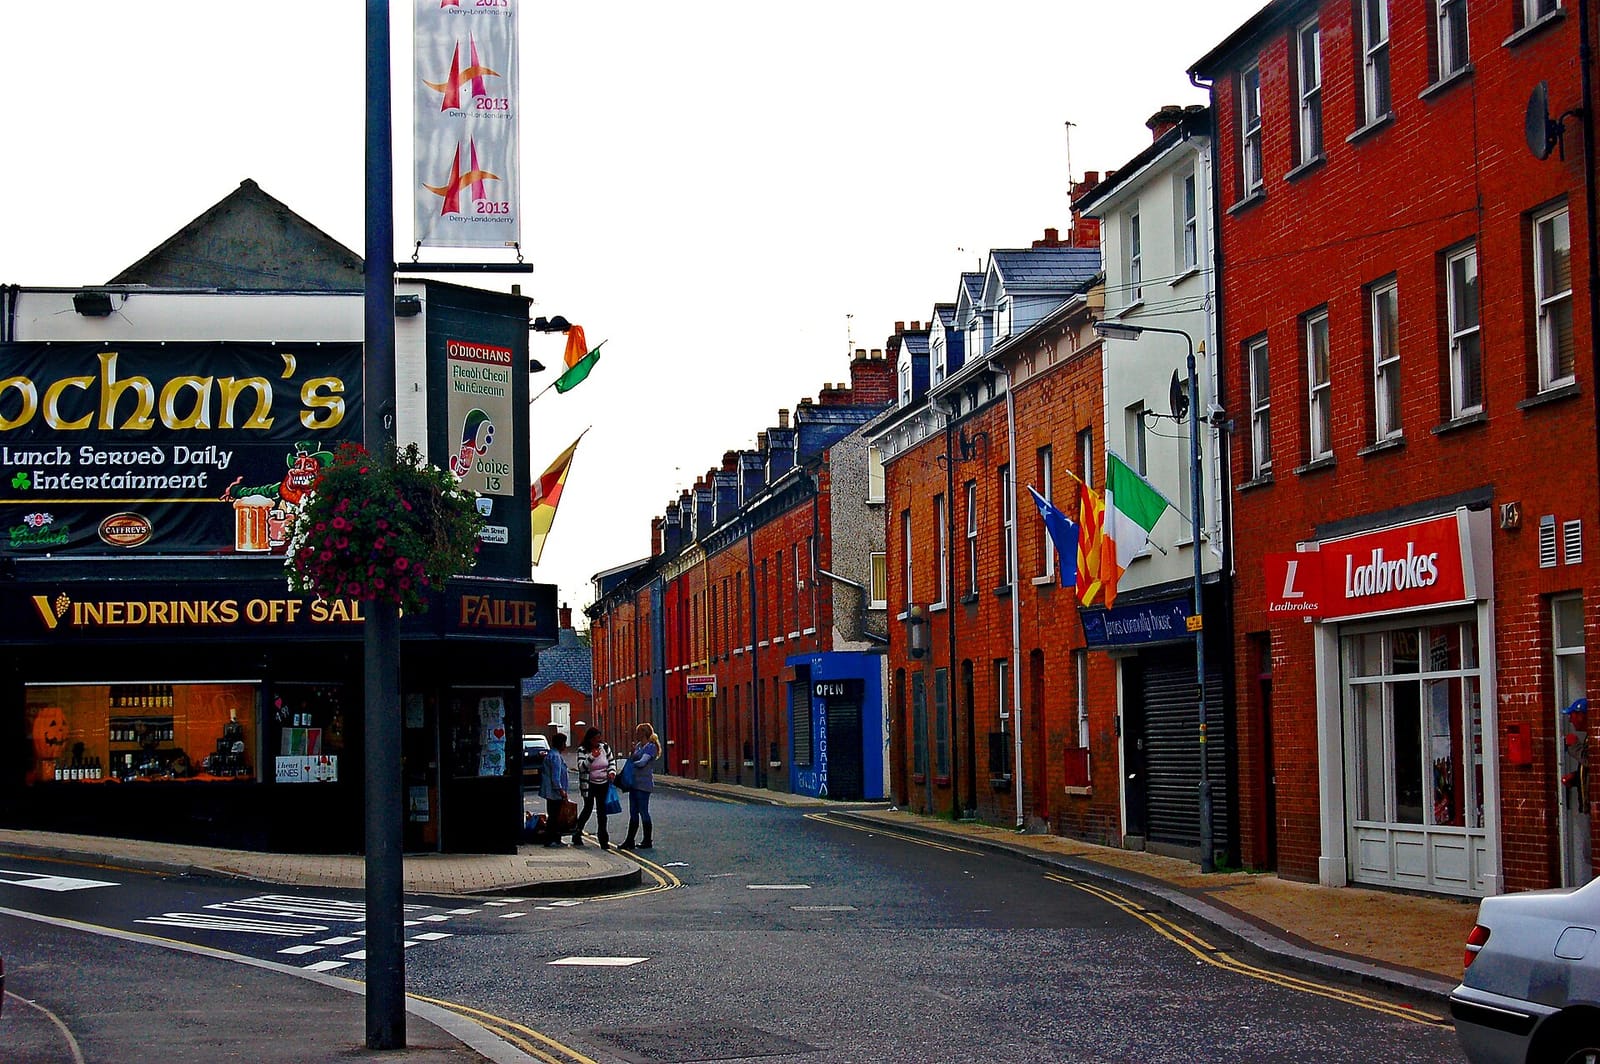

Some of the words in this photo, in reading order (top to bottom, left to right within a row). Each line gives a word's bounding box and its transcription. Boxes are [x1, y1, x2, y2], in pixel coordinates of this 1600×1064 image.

[476, 98, 508, 110] 2013
[477, 202, 509, 214] 2013
[449, 343, 511, 363] O'DIOCHANS
[453, 365, 481, 379] Fleadh
[482, 368, 508, 383] Cheoil
[3, 446, 71, 466] Lunch
[79, 445, 165, 466] Served
[173, 445, 233, 470] Daily
[33, 472, 208, 490] Entertainment
[486, 477, 501, 490] 13
[1345, 542, 1439, 599] Ladbrokes
[1282, 561, 1304, 599] L
[246, 599, 301, 623] OFF
[310, 600, 403, 622] SAL
[1269, 601, 1319, 612] Ladbrokes
[816, 683, 844, 696] OPEN
[276, 768, 299, 777] WINES
